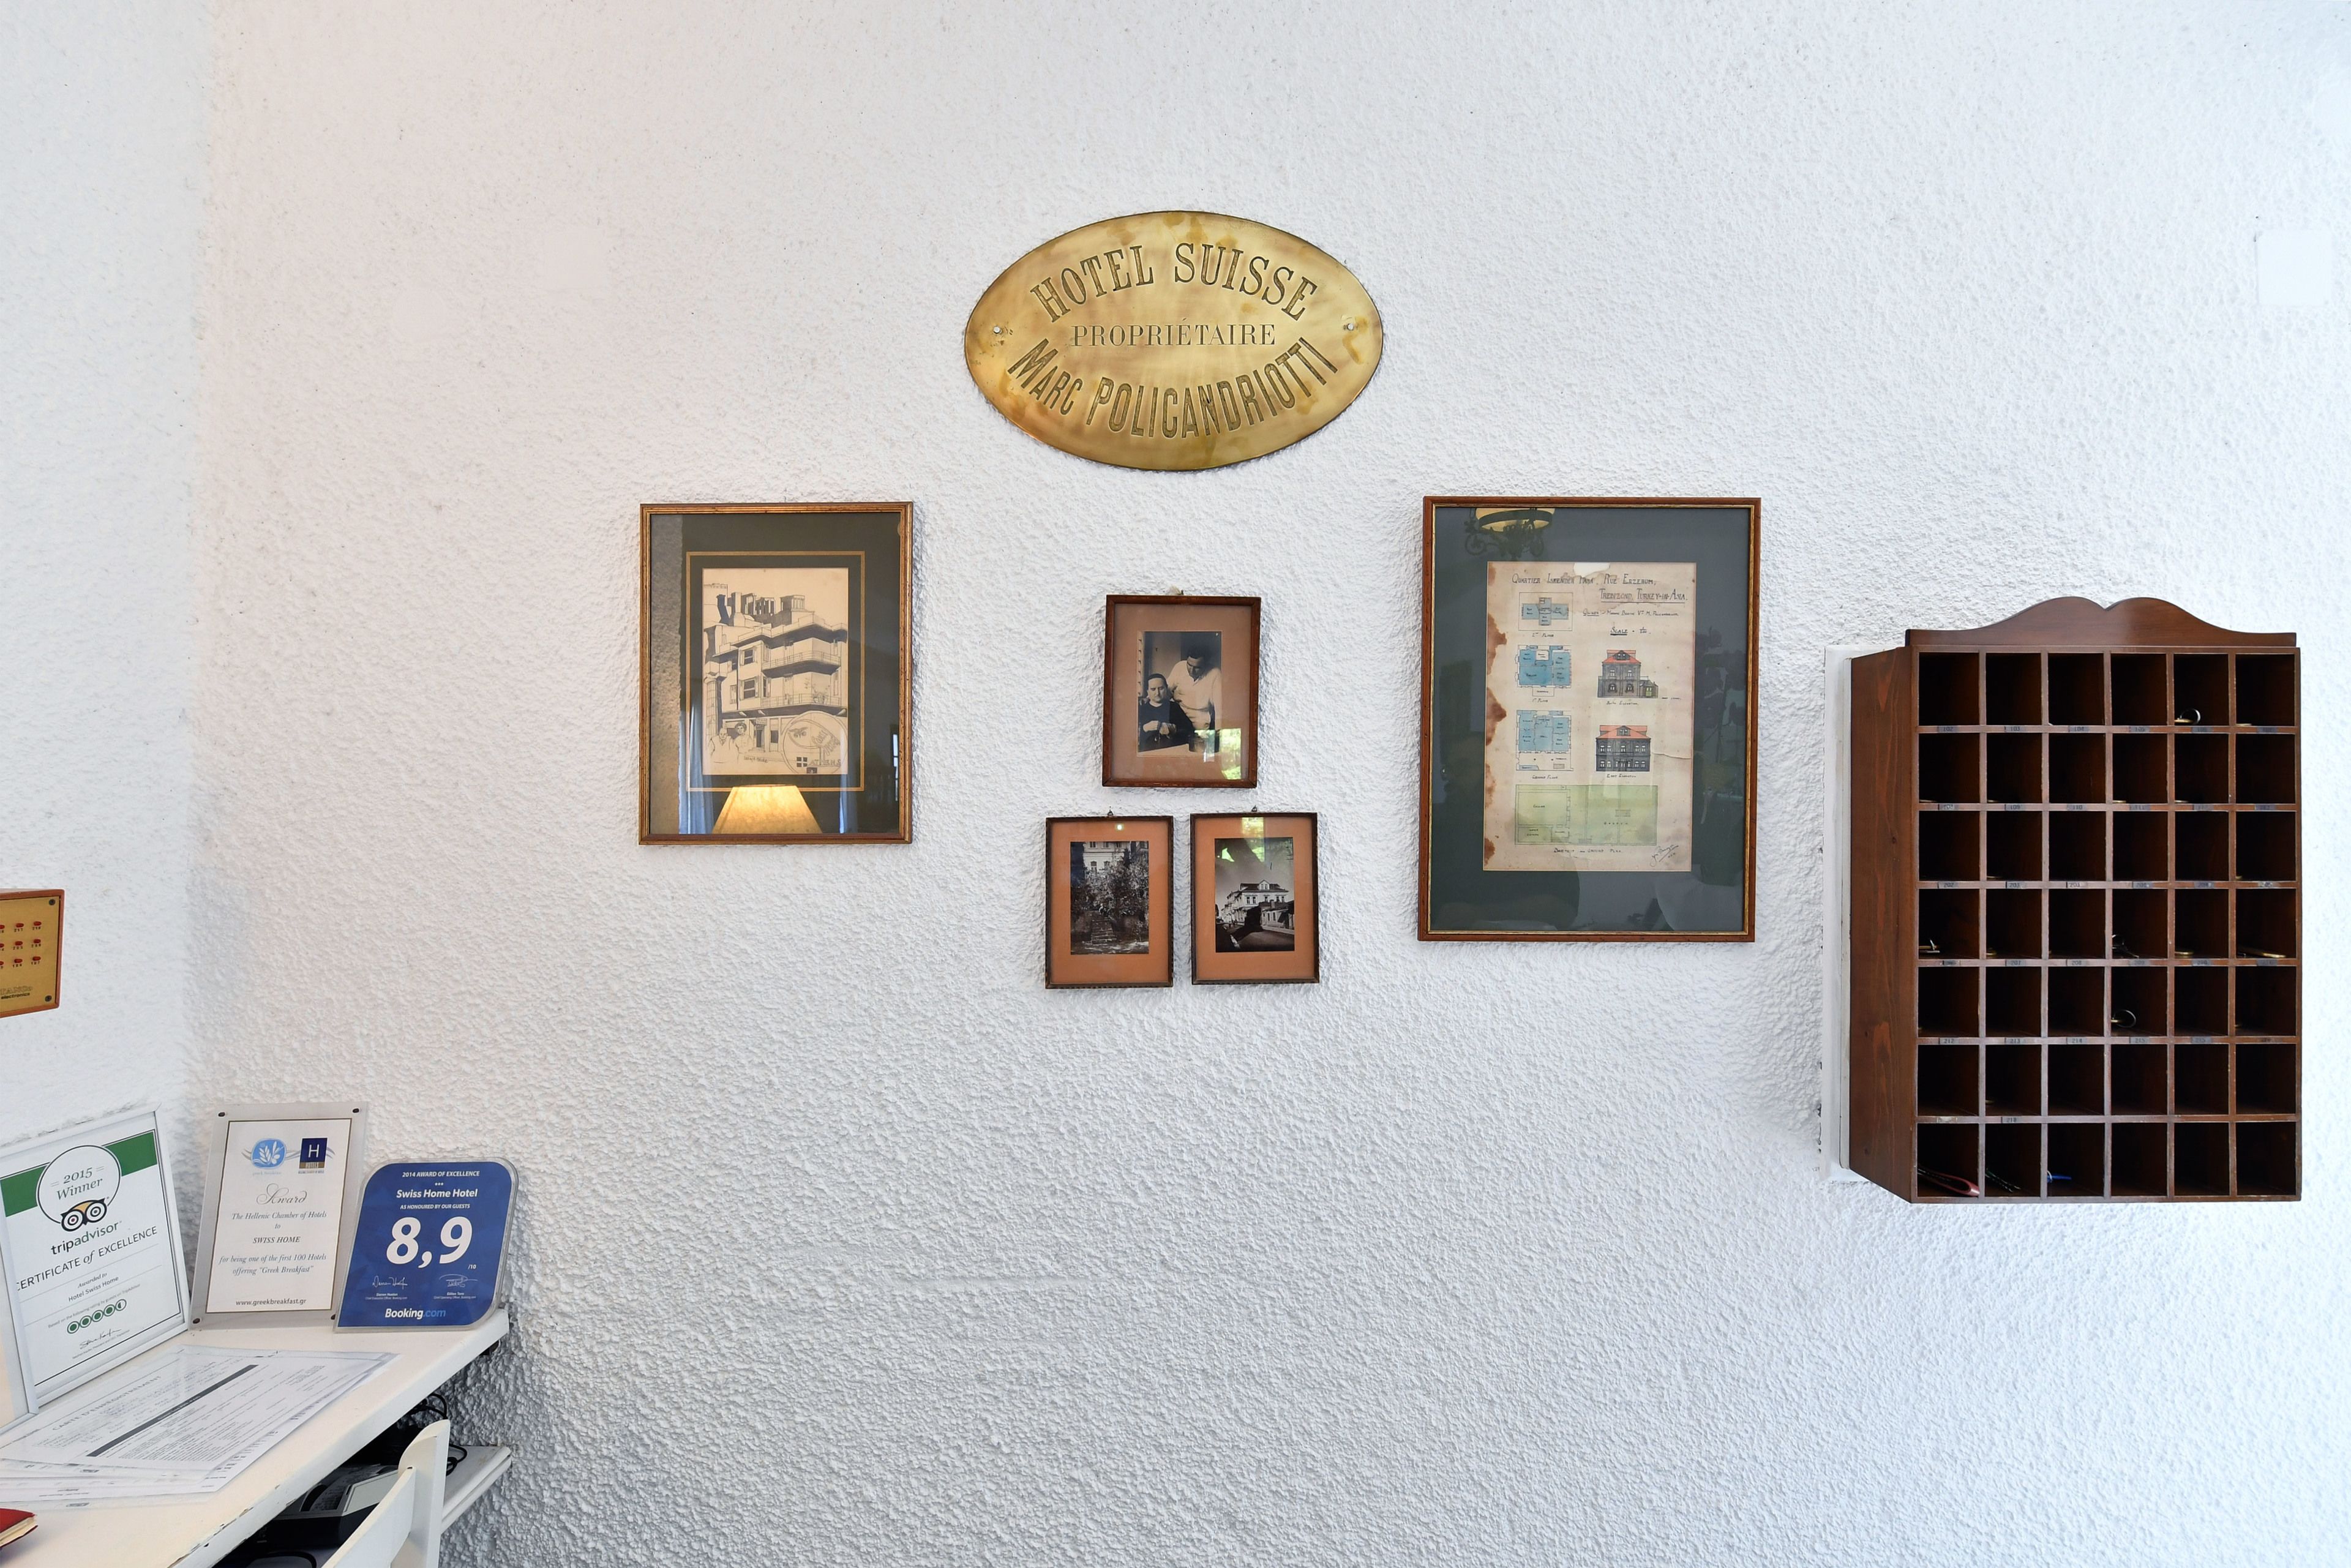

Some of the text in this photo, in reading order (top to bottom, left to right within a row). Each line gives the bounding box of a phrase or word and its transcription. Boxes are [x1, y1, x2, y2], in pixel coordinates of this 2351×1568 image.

[1030, 242, 1319, 323] HOTEL SUISSE
[1070, 317, 1276, 347] PROPRIÉTAIRE
[1085, 337, 1339, 439] POLICANDRIOTTI
[308, 1144, 320, 1158] H
[64, 1166, 93, 1185] 2015
[56, 1177, 103, 1201] Winner
[256, 1182, 307, 1205] Award
[396, 1188, 478, 1199] Swiss Home Hotel
[299, 1211, 308, 1220] of
[50, 1221, 119, 1255] tripadvisor
[83, 1250, 94, 1264] of
[98, 1226, 158, 1257] EXCELLENCE
[386, 1215, 473, 1269] 8,9
[219, 1256, 229, 1265] for
[230, 1255, 247, 1264] being
[260, 1255, 268, 1264] of
[278, 1254, 292, 1263] first
[77, 1275, 102, 1289] Awarded
[232, 1267, 257, 1276] offering
[68, 1276, 119, 1302] Hotel Swiss Home
[385, 1308, 446, 1319] Booking.com
